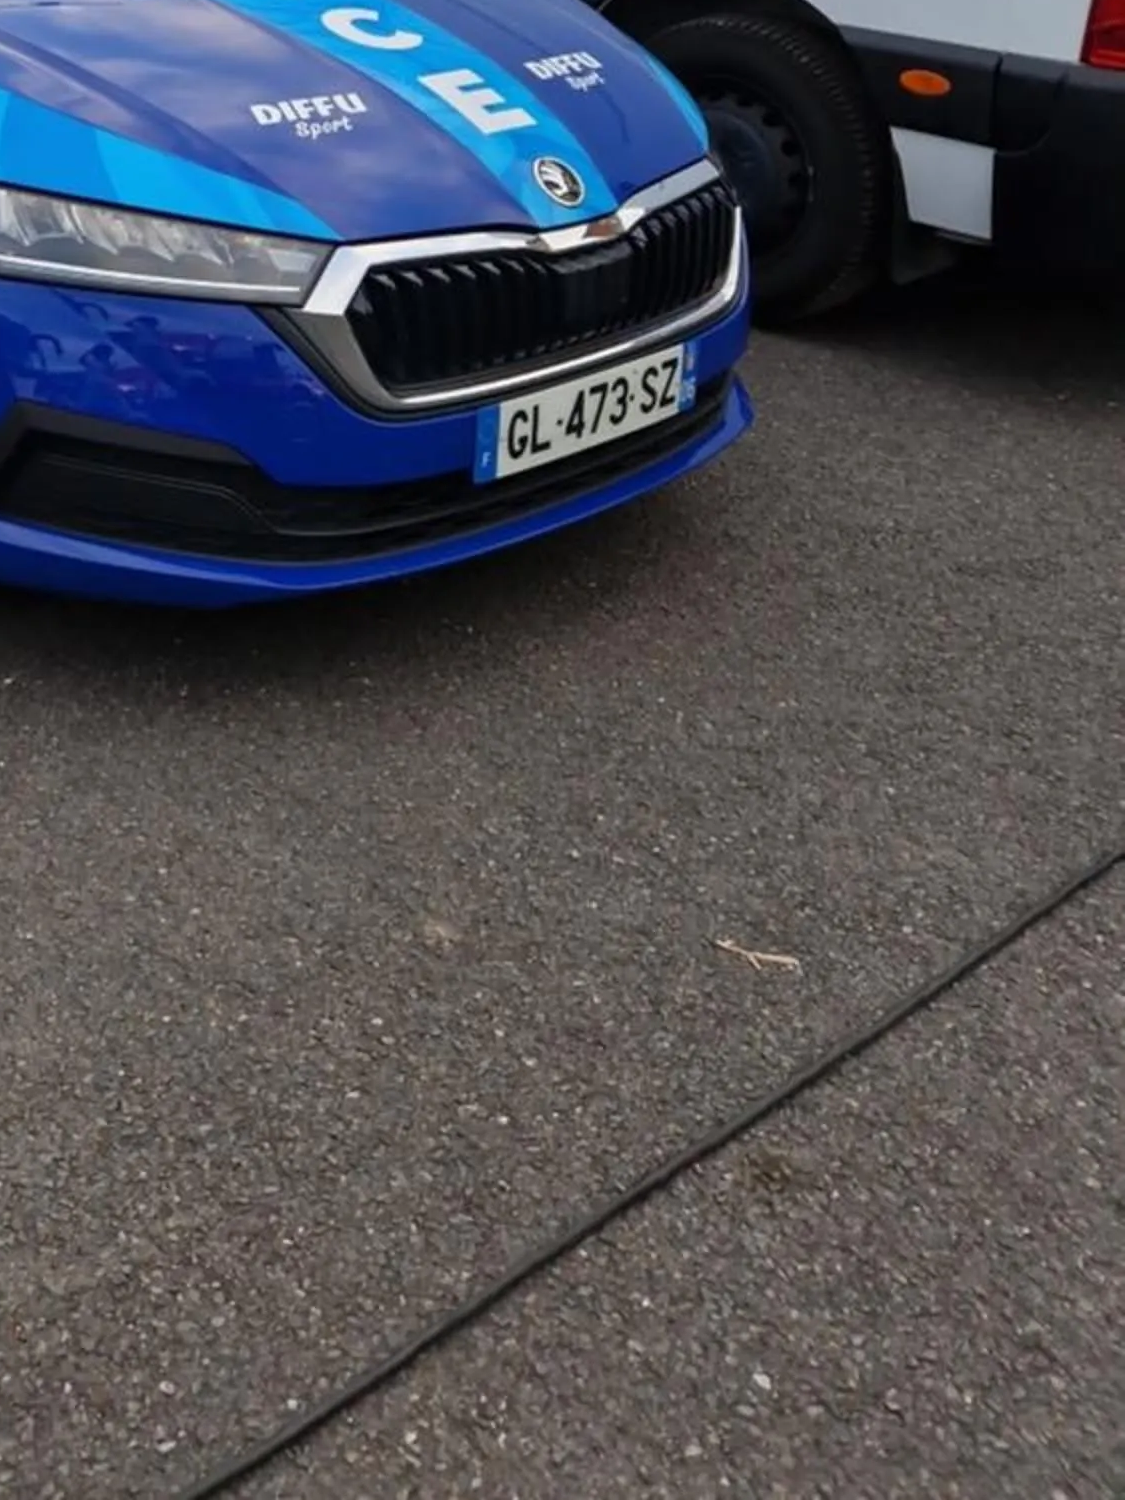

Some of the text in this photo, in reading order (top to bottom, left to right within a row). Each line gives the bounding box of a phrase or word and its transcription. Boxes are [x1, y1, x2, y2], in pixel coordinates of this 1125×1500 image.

[523, 51, 603, 80] DIFFU
[250, 92, 367, 126] DIFFU
[295, 115, 353, 140] Sport
